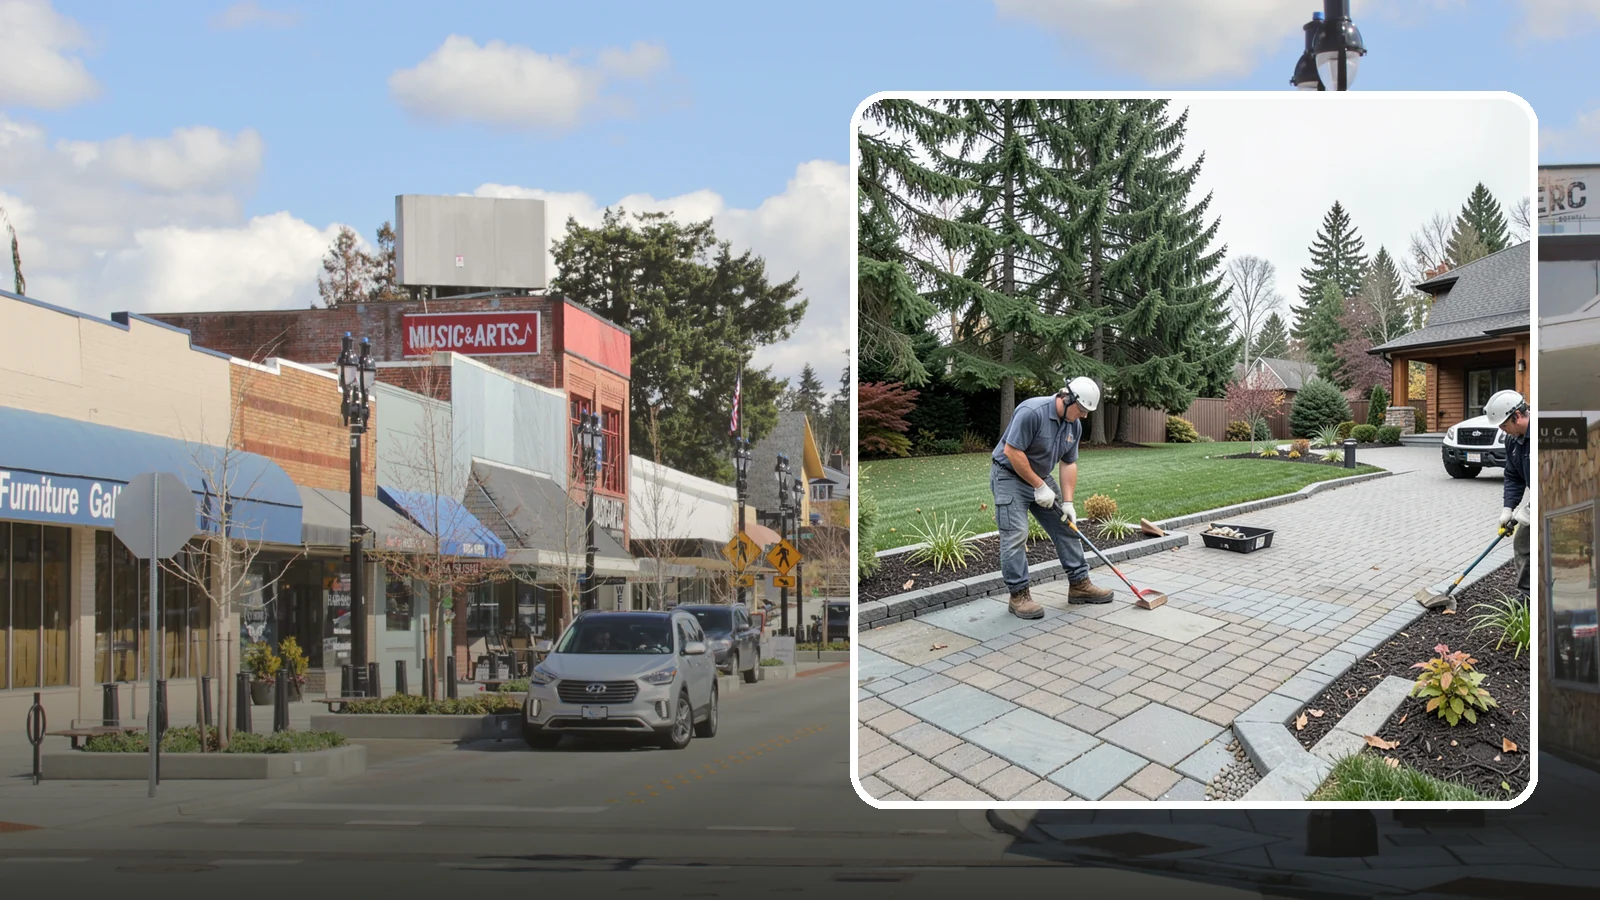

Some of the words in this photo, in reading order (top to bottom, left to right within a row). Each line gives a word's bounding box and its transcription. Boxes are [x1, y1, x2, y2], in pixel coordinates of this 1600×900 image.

[1540, 427, 1577, 437] UGA
[0, 471, 79, 515] Furniture
[89, 482, 122, 519] Gal
